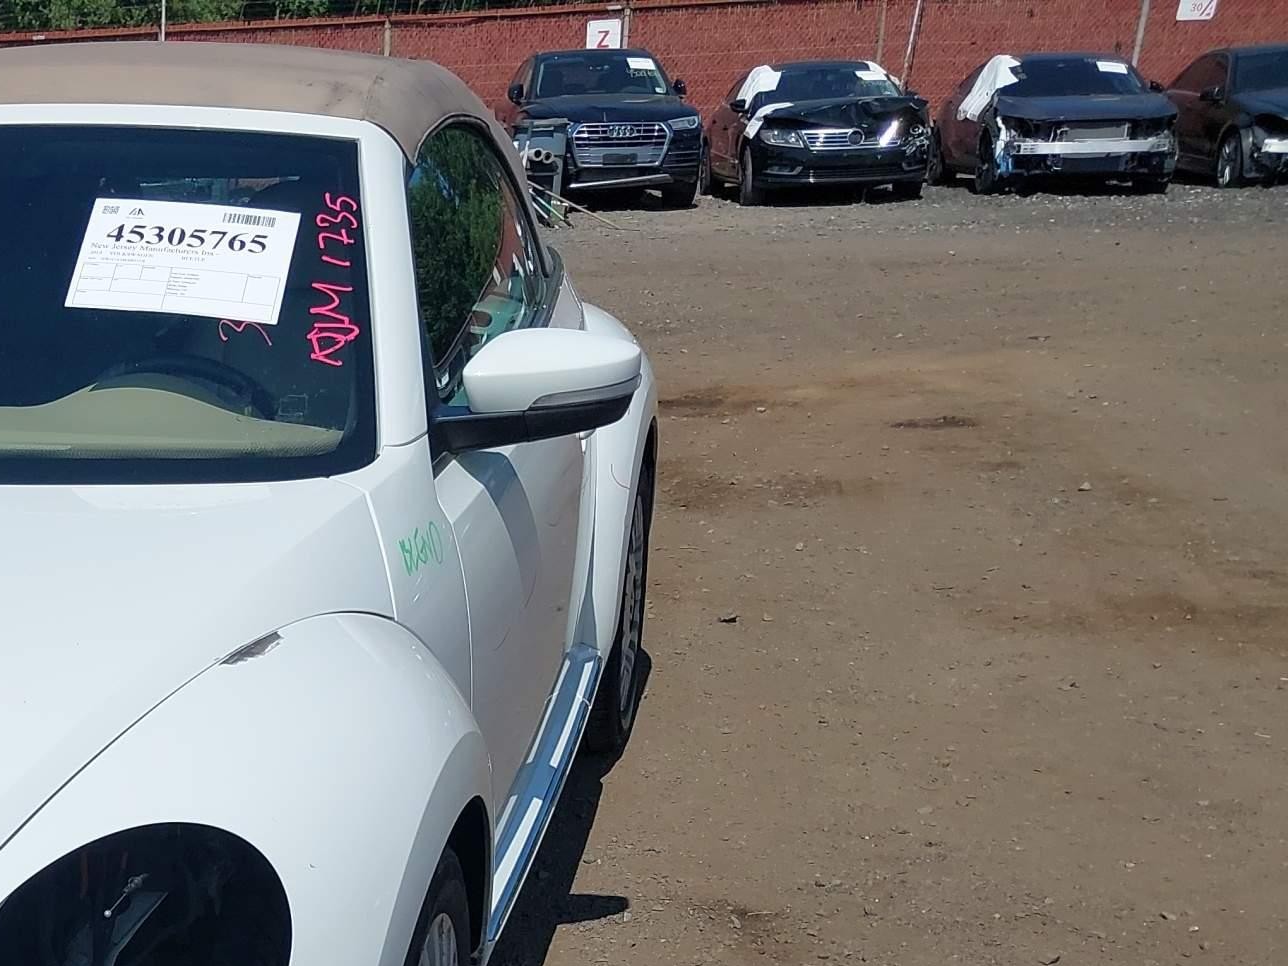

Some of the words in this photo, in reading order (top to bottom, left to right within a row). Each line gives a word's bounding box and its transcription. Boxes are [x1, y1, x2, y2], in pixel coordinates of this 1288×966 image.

[106, 223, 269, 254] 45305765
[315, 192, 359, 267] 1735
[91, 242, 108, 250] New
[112, 243, 137, 251] Jersey
